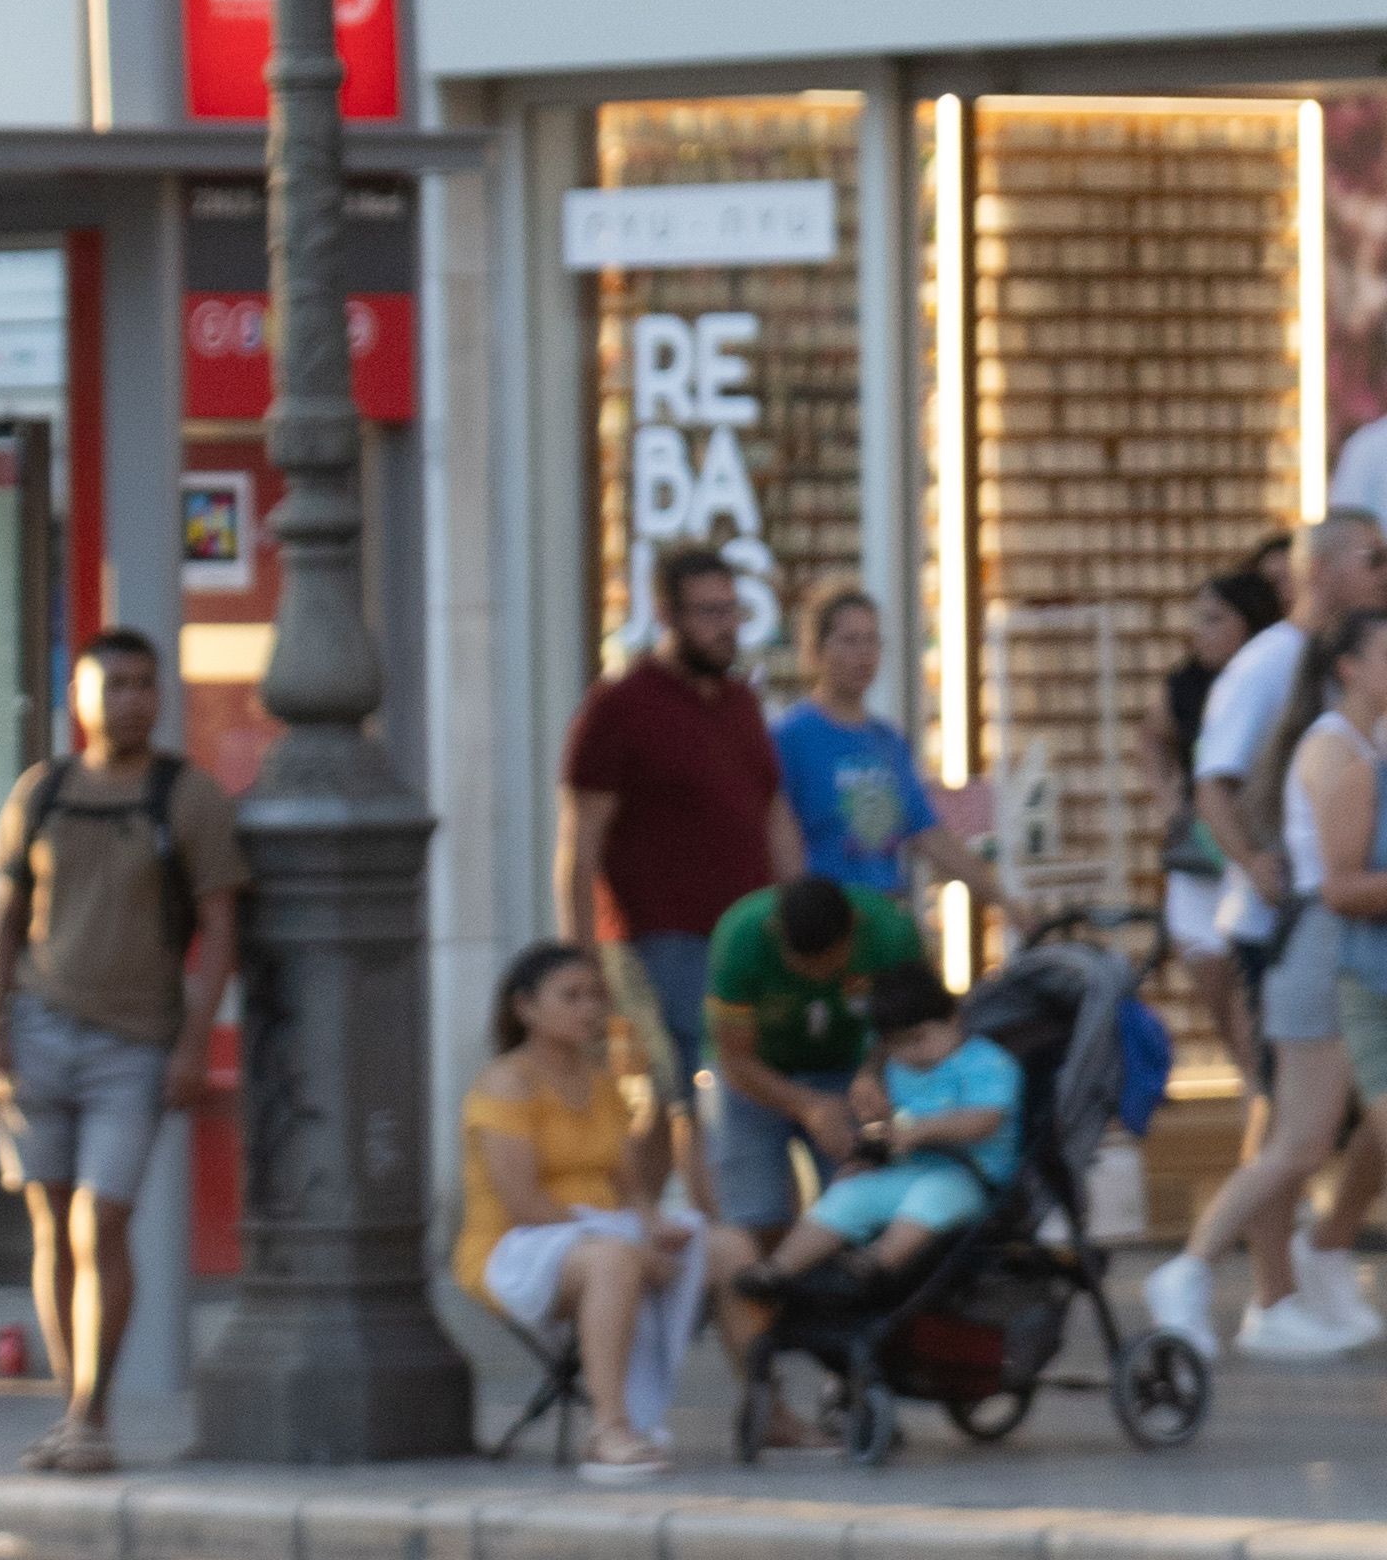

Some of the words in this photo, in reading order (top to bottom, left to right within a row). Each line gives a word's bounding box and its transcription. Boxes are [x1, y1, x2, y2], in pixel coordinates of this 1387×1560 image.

[632, 312, 760, 424] RE
[633, 425, 761, 540] BA
[621, 538, 782, 651] JS
